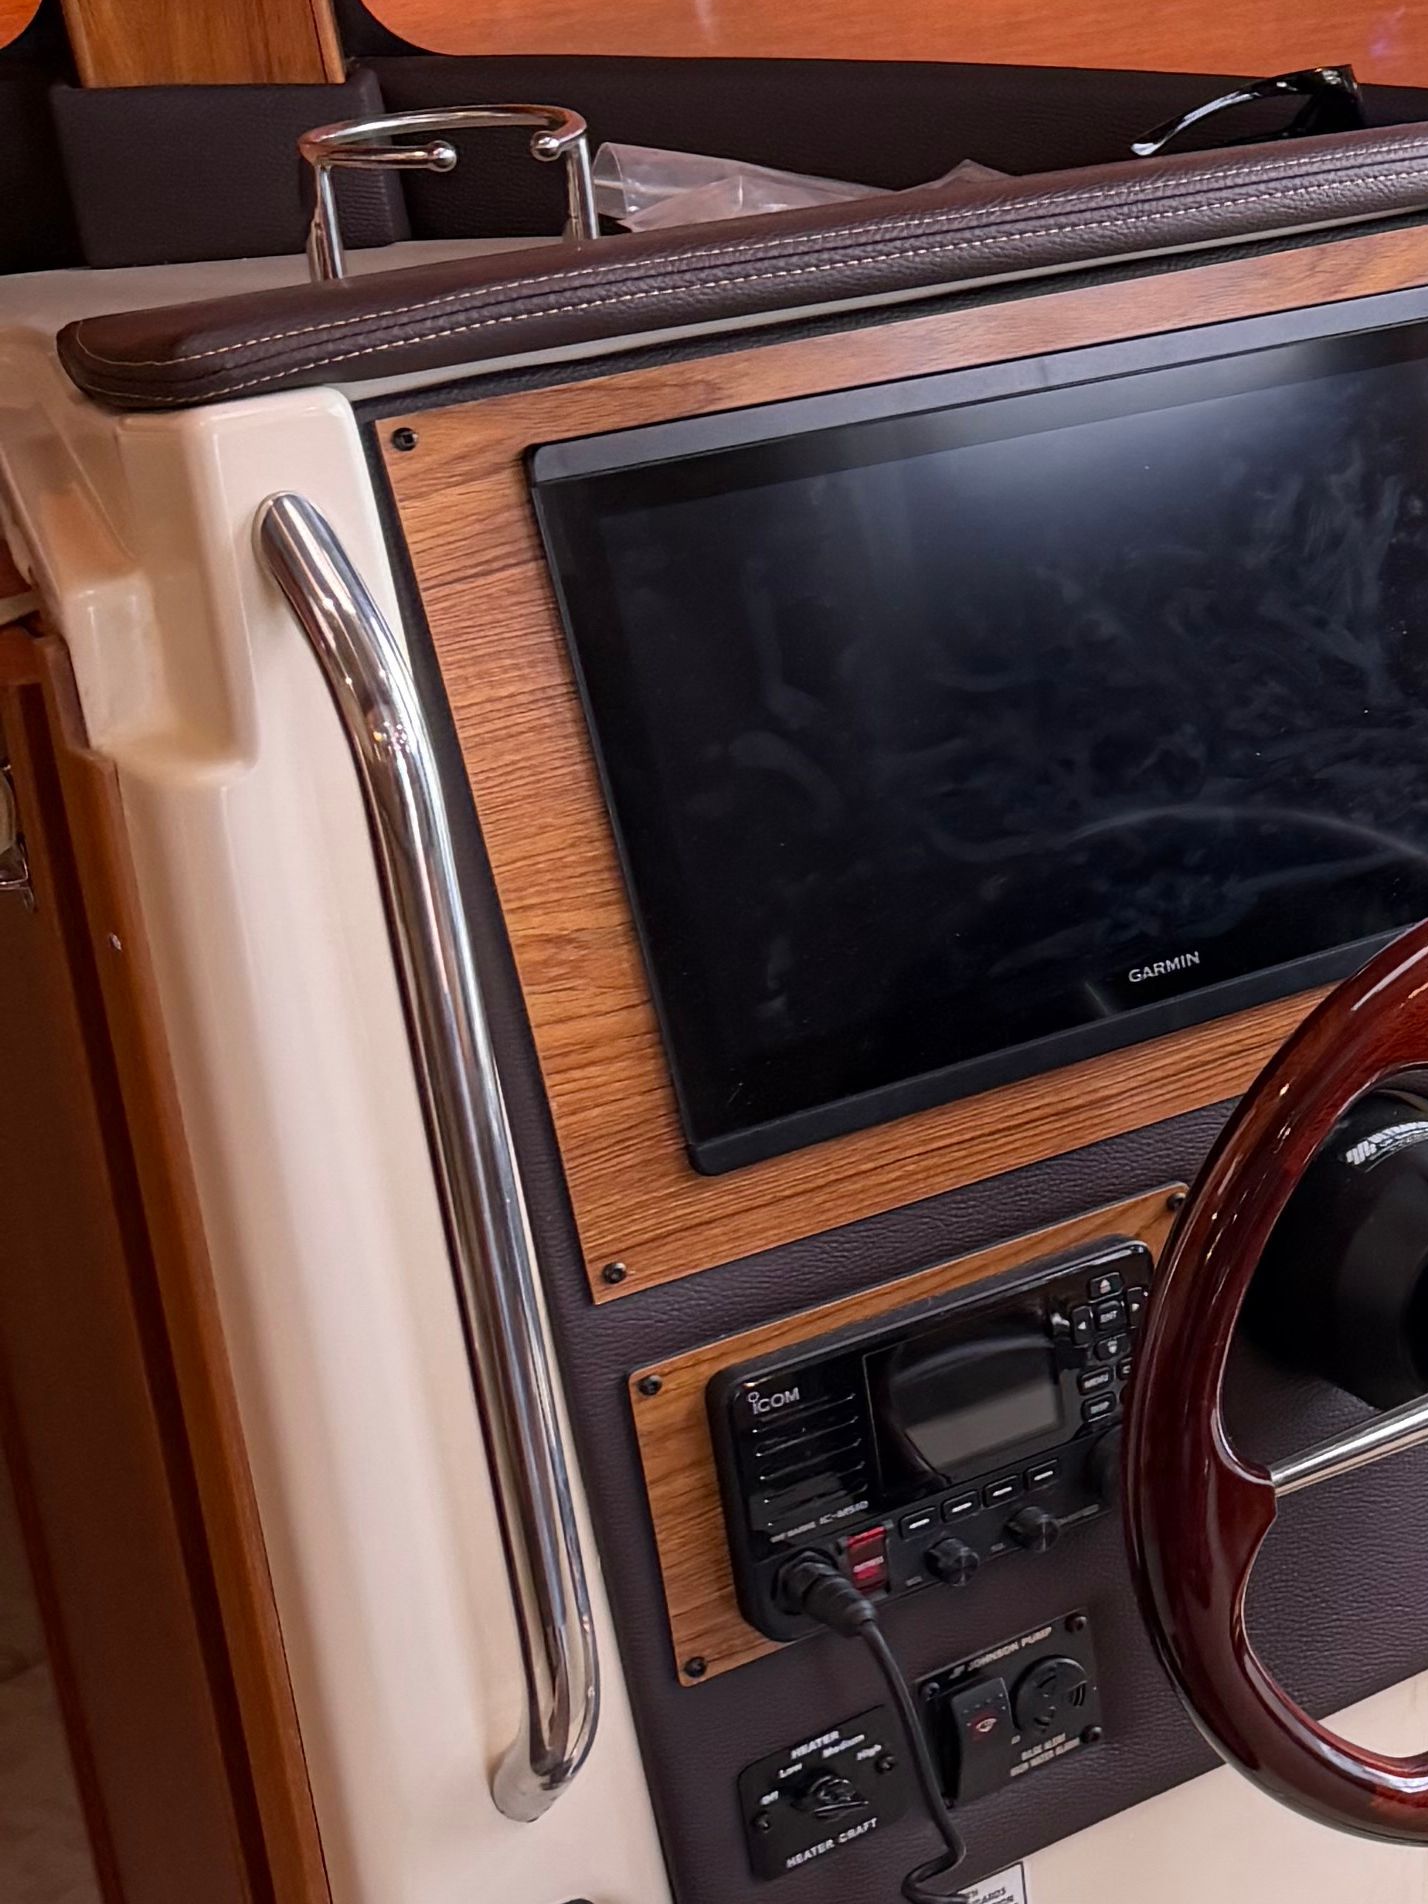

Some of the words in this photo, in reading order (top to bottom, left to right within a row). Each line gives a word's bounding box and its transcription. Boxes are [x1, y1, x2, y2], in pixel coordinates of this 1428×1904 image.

[1128, 951, 1201, 983] GARMIN
[968, 1642, 1019, 1671] JOHNSON
[791, 1731, 839, 1760] HEATER
[786, 1839, 835, 1868] HEATER
[838, 1818, 877, 1843] CRAFT
